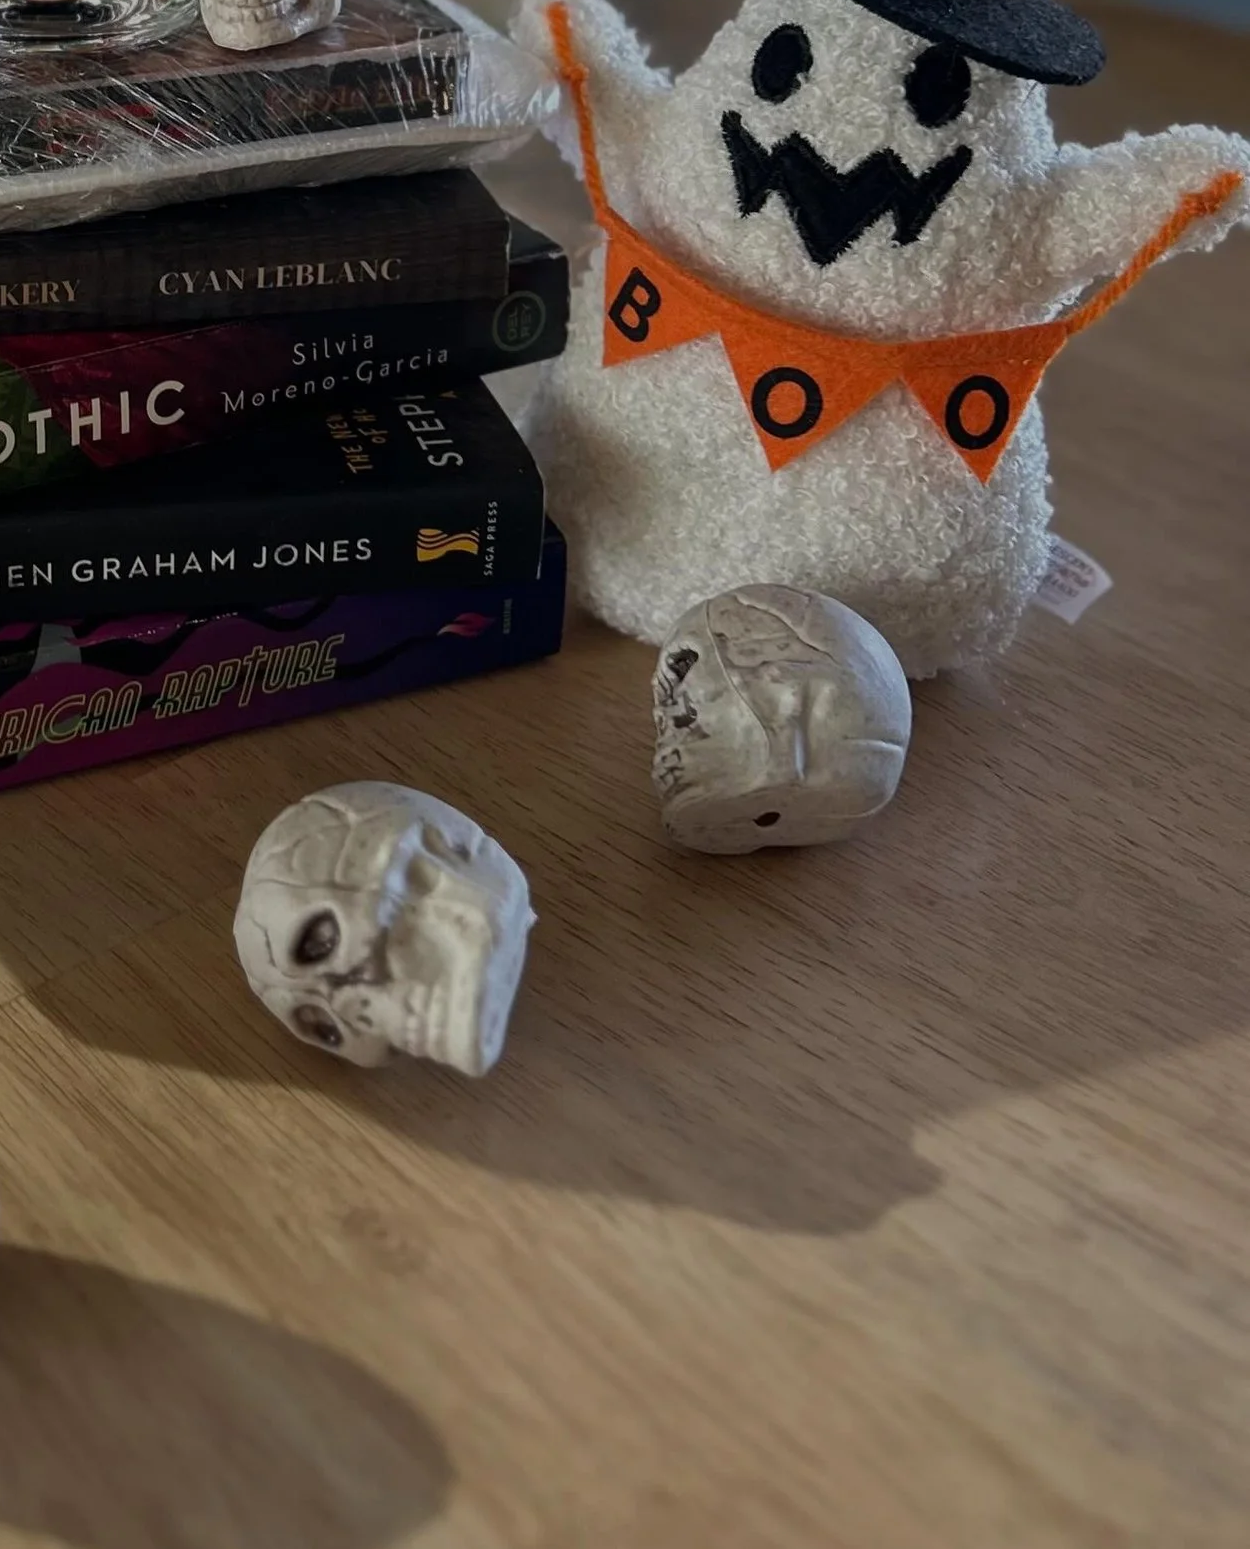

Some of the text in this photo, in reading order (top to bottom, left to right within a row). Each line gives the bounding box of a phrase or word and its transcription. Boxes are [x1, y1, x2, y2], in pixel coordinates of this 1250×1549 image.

[158, 266, 246, 297] CYAN
[255, 257, 403, 291] LEBLANC
[292, 332, 375, 365] Silvia
[223, 346, 449, 415] Moreno-Garcia
[71, 548, 236, 583] GRAHAM
[252, 537, 372, 570] JONES
[483, 500, 498, 577] SAGA PRESS
[152, 634, 345, 719] RAPTURE
